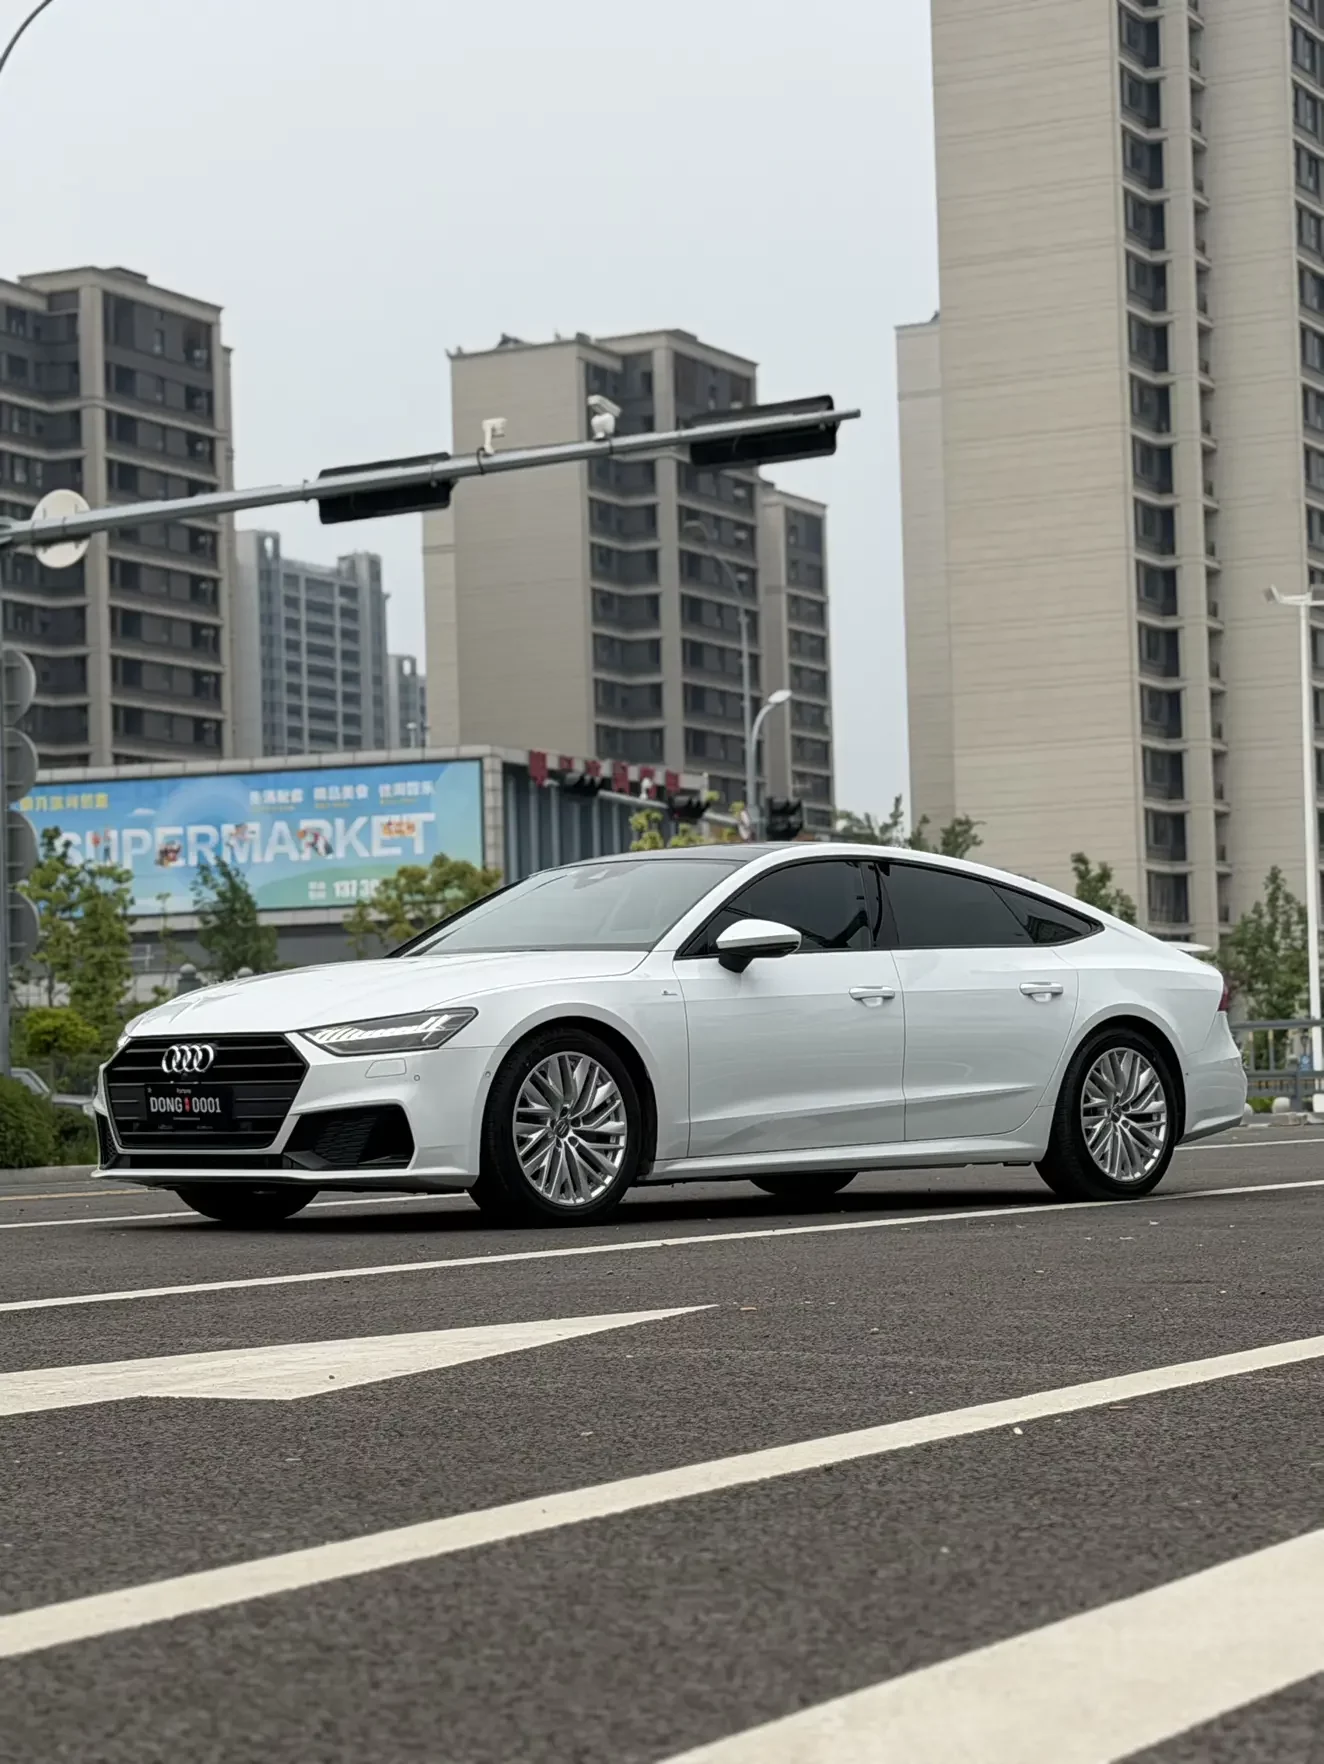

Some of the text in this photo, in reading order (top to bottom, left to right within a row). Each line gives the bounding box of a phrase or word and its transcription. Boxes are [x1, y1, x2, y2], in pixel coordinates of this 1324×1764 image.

[55, 812, 435, 871] SUPERMARKET
[149, 1096, 222, 1113] DONG 0001
